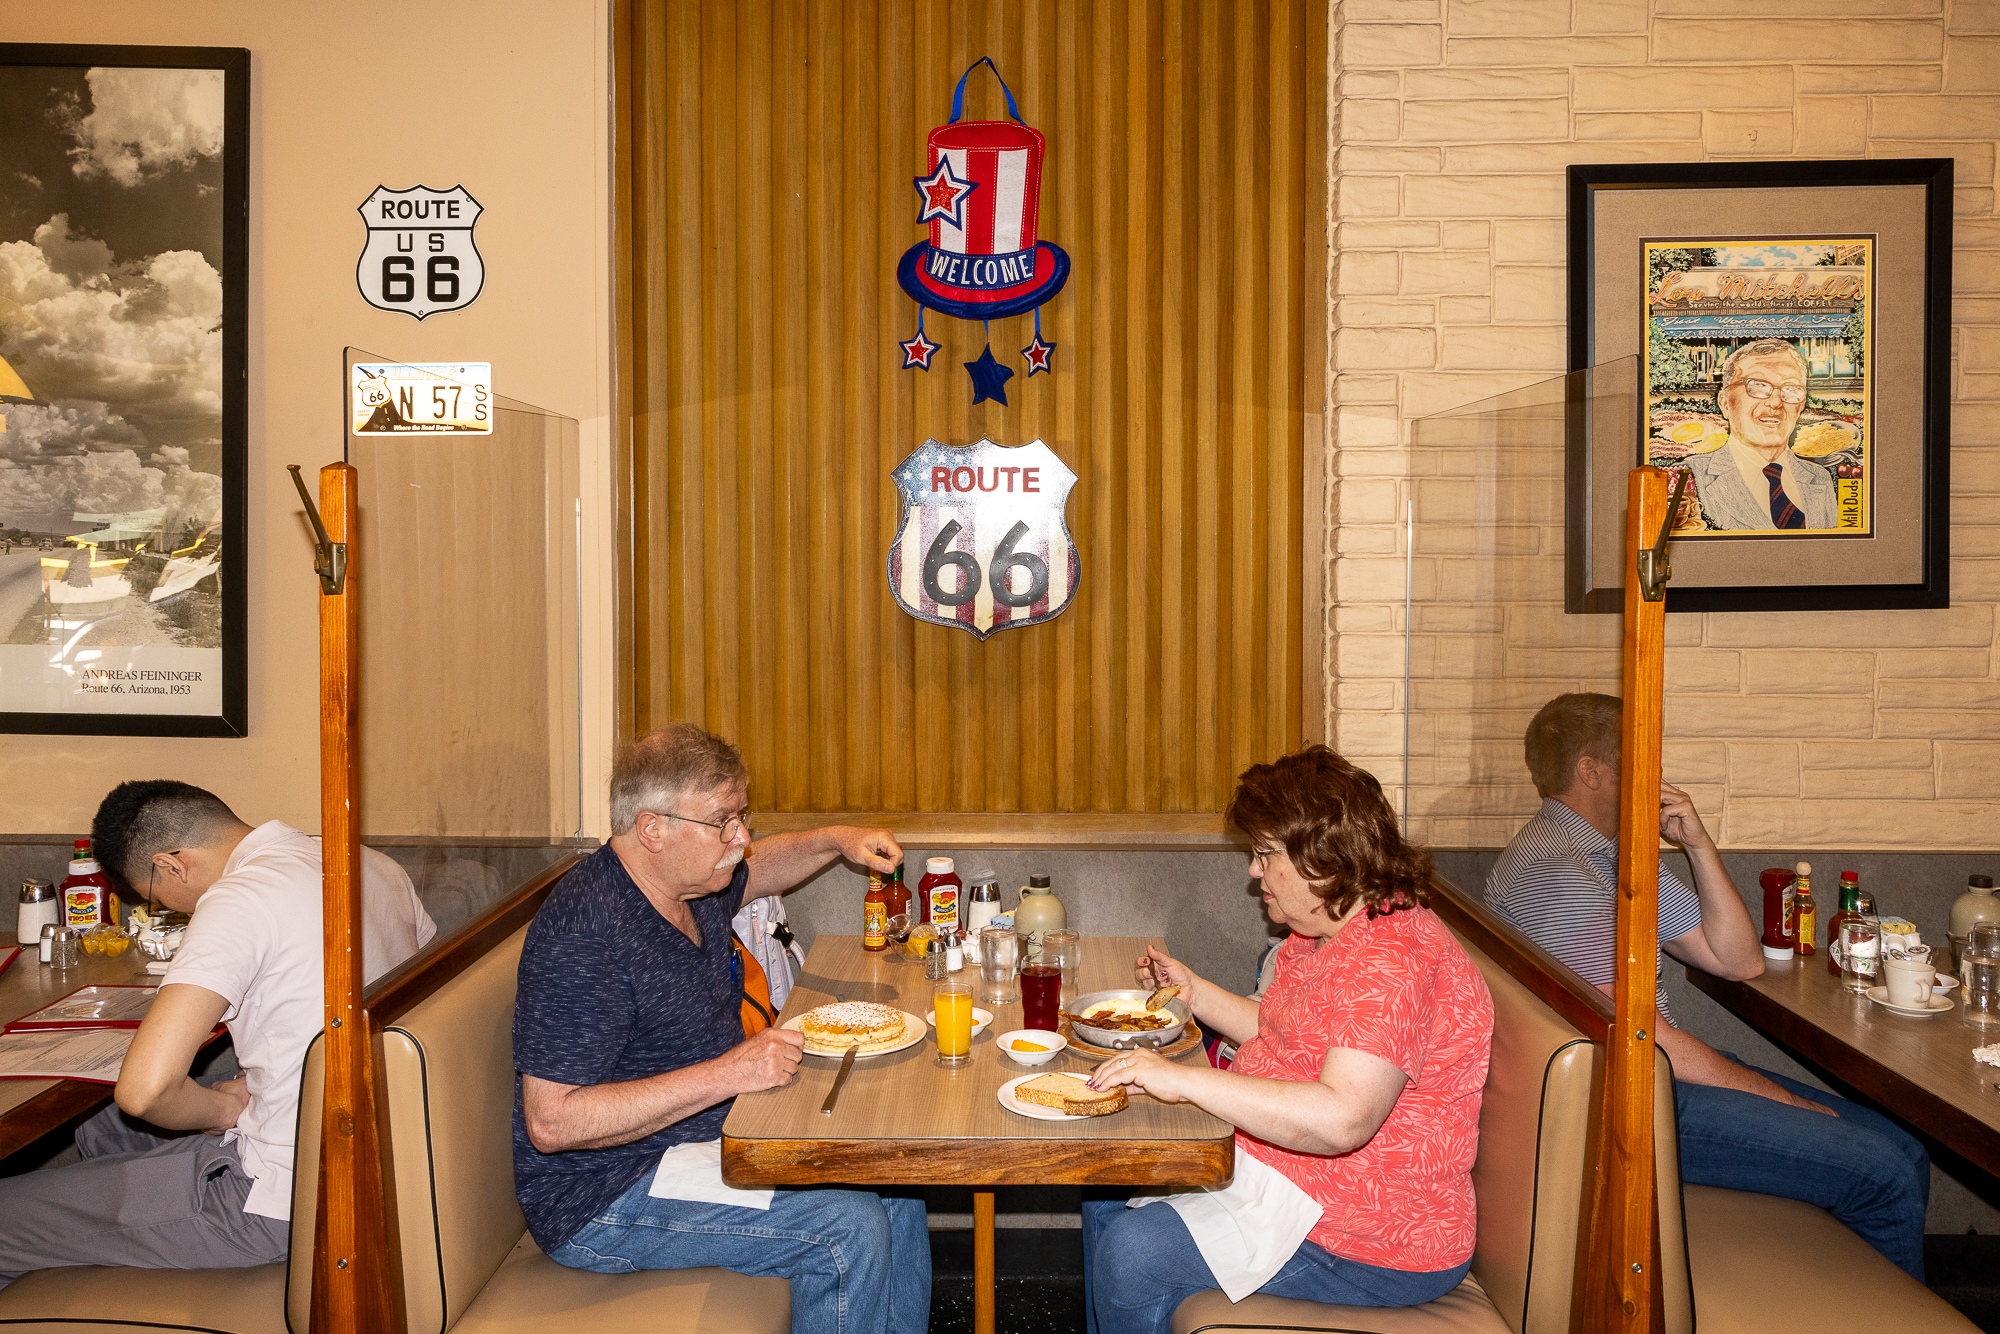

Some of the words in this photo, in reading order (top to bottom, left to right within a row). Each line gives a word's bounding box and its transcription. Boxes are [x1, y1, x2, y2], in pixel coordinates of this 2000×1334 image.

[382, 200, 460, 219] ROUTE
[382, 256, 460, 302] 66
[930, 251, 1033, 286] WELCOME
[1649, 272, 1705, 307] Lou
[1719, 273, 1864, 301] Mitchell's
[1689, 301, 1720, 309] Serving
[391, 367, 457, 381] ILLINOIS
[370, 390, 384, 403] 66
[400, 386, 413, 419] N
[433, 386, 462, 419] 57
[435, 424, 455, 432] Begins
[931, 467, 1040, 493] ROUTE
[1843, 480, 1858, 505] Duds
[1841, 507, 1858, 528] Milk
[922, 518, 1049, 608] 66
[82, 670, 138, 680] ANDREAS
[140, 671, 203, 682] FEININGER
[82, 683, 109, 693] Route
[110, 684, 125, 695] 66,
[128, 684, 168, 695] Arizona,
[170, 684, 191, 695] 1953
